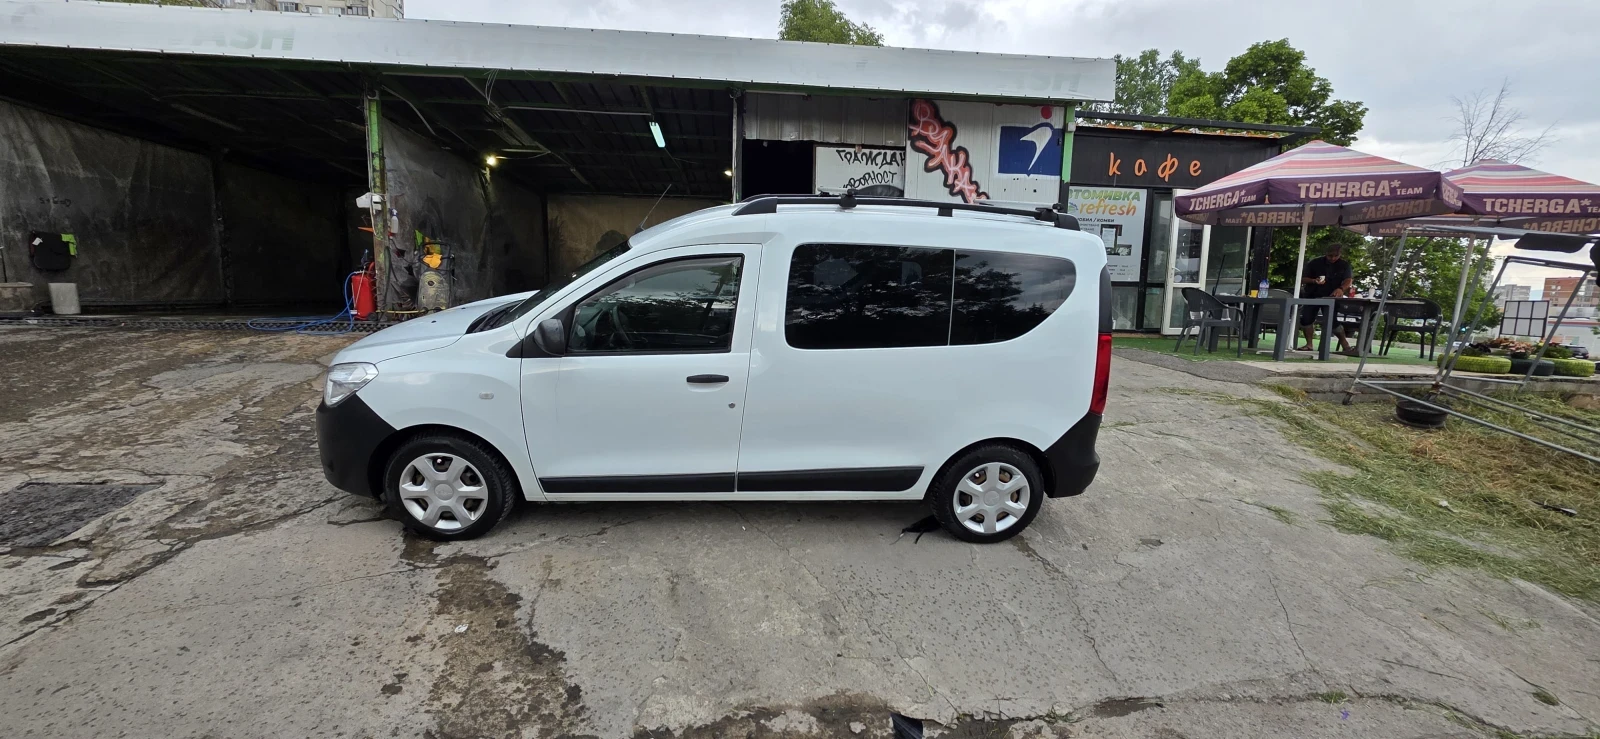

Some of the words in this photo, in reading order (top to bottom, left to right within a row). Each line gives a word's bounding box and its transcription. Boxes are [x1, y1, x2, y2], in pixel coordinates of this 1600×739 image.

[1109, 151, 1202, 182] кафе
[1396, 186, 1423, 196] TEAM
[1241, 194, 1256, 203] TEAM
[1079, 198, 1137, 217] refresh
